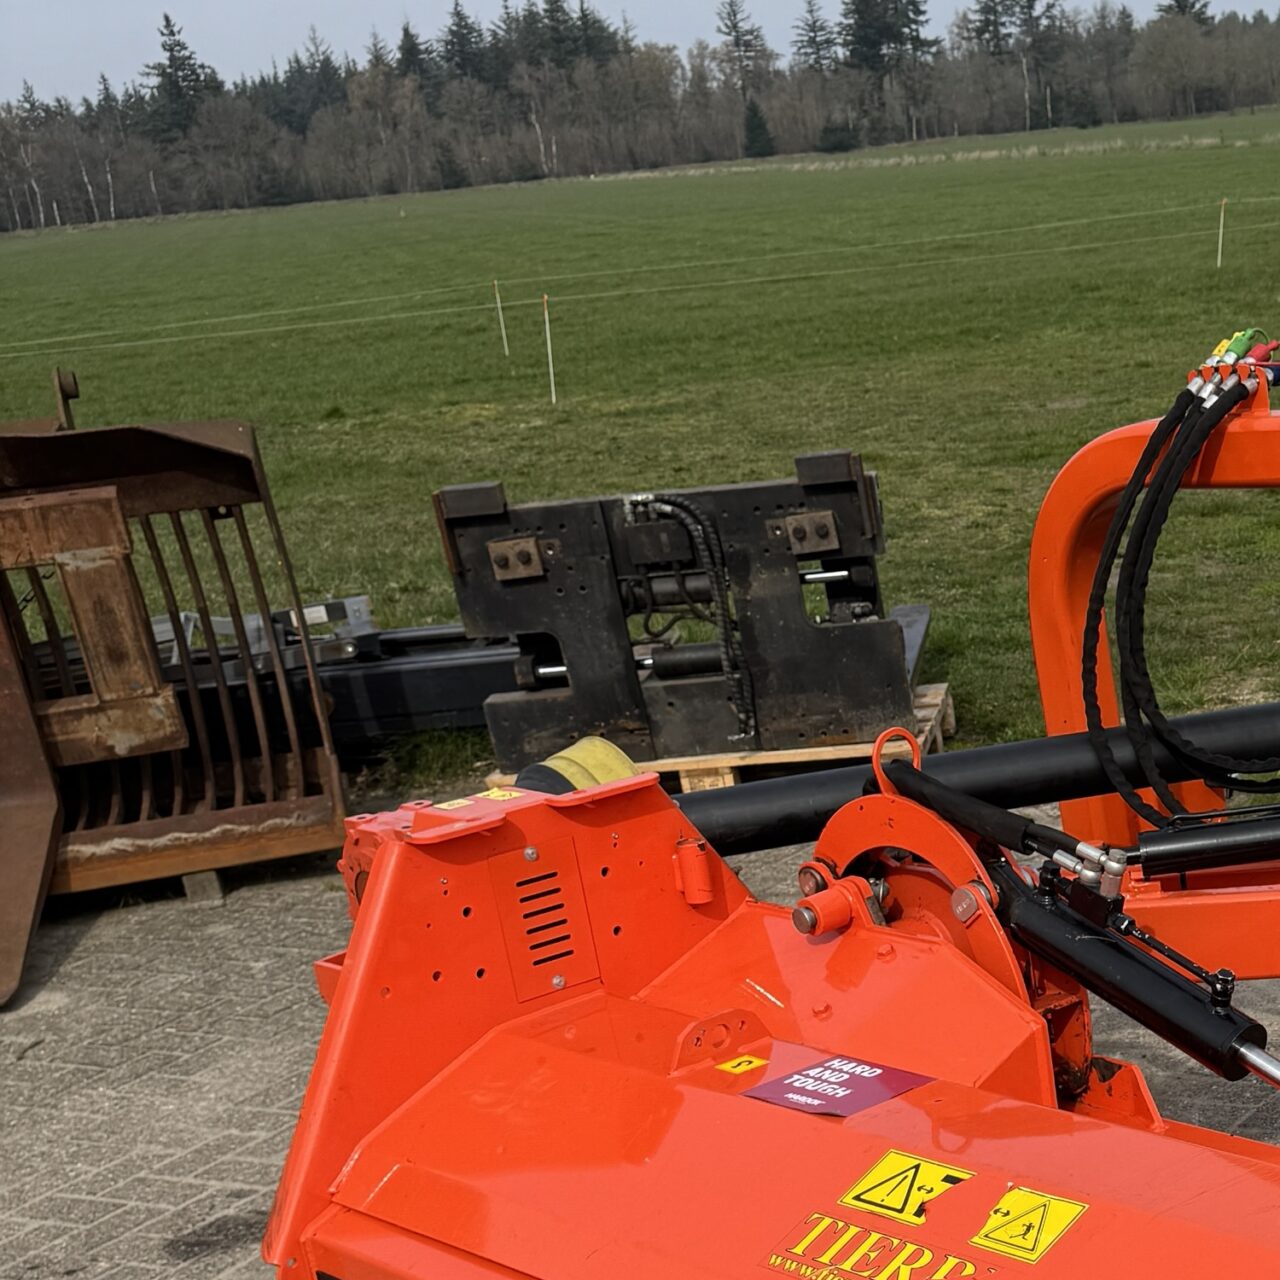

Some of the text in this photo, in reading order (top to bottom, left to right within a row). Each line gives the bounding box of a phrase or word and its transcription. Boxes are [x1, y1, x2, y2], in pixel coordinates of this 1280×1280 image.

[802, 1067, 850, 1083] AND
[824, 1058, 883, 1078] HARD
[784, 1075, 853, 1098] TOUGH
